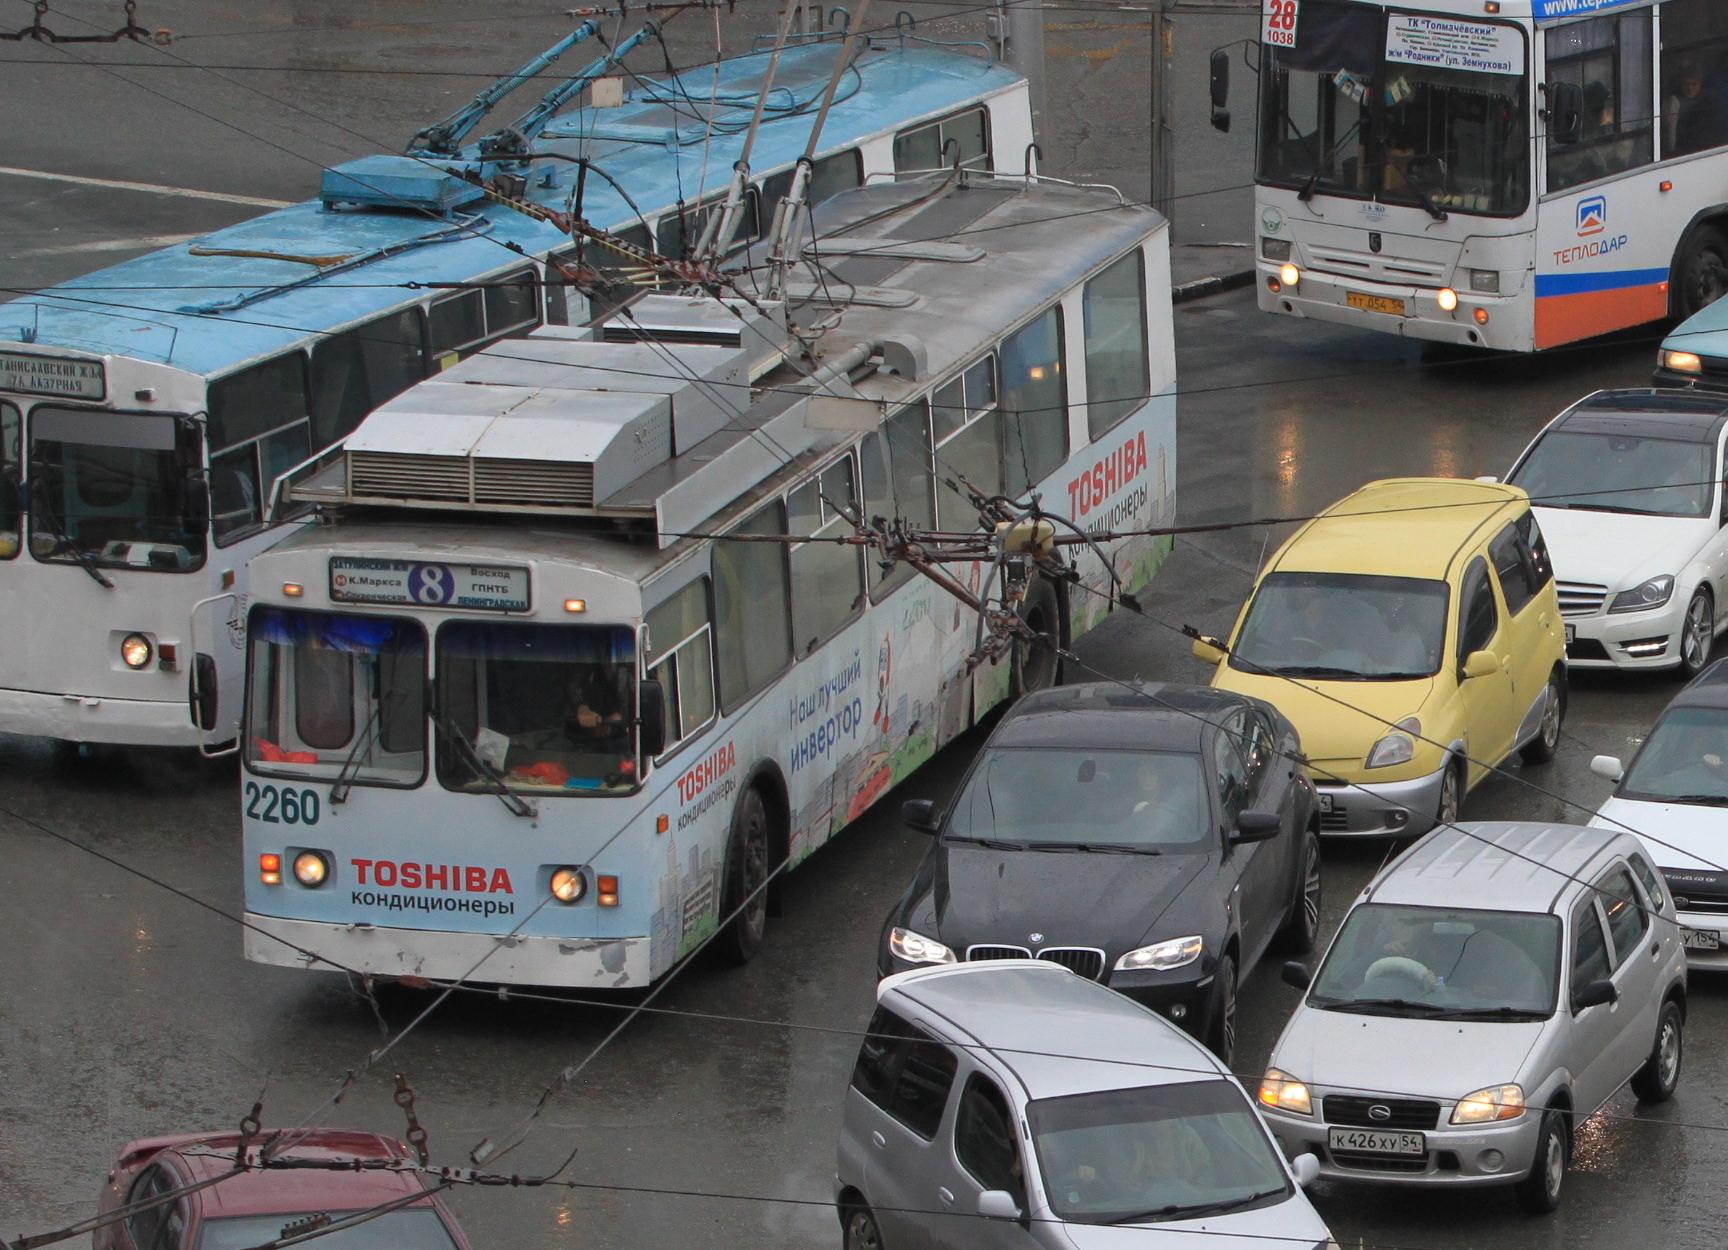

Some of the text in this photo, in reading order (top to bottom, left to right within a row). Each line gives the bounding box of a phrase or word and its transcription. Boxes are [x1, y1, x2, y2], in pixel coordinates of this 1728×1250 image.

[1269, 0, 1296, 30] 28
[1407, 18, 1419, 28] ТК
[1267, 30, 1294, 45] 1038
[1553, 235, 1628, 266] ТЕПЛОДАР
[0, 360, 76, 378] ТАНИСЛАВСКИЙ
[1068, 430, 1148, 525] TOSHIBA
[349, 577, 402, 587] К.Маркса
[419, 564, 445, 604] 8
[471, 568, 511, 580] Восход
[472, 583, 510, 594] ГПНТБ
[789, 650, 862, 731] Наш лучший
[791, 697, 863, 776] инвертор
[677, 740, 737, 807] TOSHIBA
[245, 781, 321, 826] 2260
[677, 775, 738, 833] кондиционеры
[351, 858, 514, 894] TOSHIBA
[351, 890, 515, 918] кондиционеры
